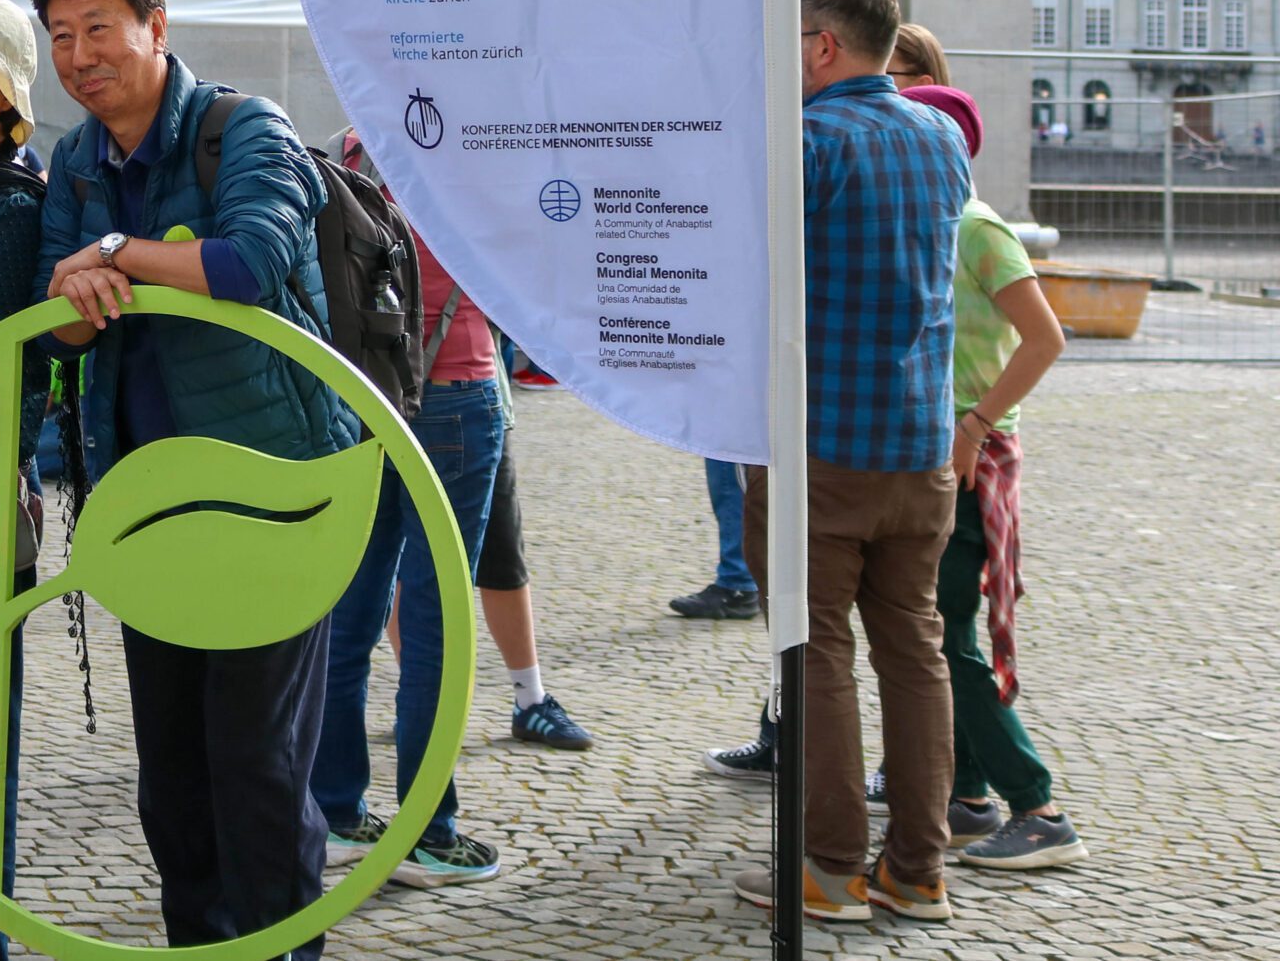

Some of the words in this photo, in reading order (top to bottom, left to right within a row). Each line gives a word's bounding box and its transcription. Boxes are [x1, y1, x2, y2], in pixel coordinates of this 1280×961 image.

[391, 32, 464, 46] reformierte
[393, 48, 428, 60] kirche
[432, 48, 478, 60] kanton
[482, 46, 522, 59] zürich
[462, 124, 532, 135] KONFERENZ
[535, 123, 557, 133] DER
[560, 122, 639, 133] MENNONITEN
[642, 122, 664, 132] DER
[667, 121, 722, 131] SCHWEIZ
[463, 137, 540, 150] CONFÉRENCE
[543, 138, 613, 148] MENNONITE
[616, 137, 653, 147] SUISSE
[594, 187, 660, 199] Mennonite
[594, 202, 631, 213] World
[636, 202, 708, 213] Conference
[595, 219, 602, 227] A
[604, 219, 653, 230] Community
[655, 219, 663, 228] of
[666, 219, 712, 229] Anabaptist
[596, 230, 626, 238] related
[628, 230, 670, 239] Churches
[596, 252, 658, 266] Congreso
[597, 267, 646, 278] Mundial
[651, 268, 707, 279] Menonita
[598, 284, 615, 292] Una
[617, 284, 667, 293] Comunidad
[670, 285, 680, 293] de
[598, 295, 630, 305] Iglesias
[632, 295, 688, 304] Anabautistas
[599, 316, 670, 329] Conférence
[600, 331, 664, 344] Mennonite
[668, 333, 725, 345] Mondiale
[599, 348, 616, 356] Une
[640, 360, 696, 370] Anabaptistes
